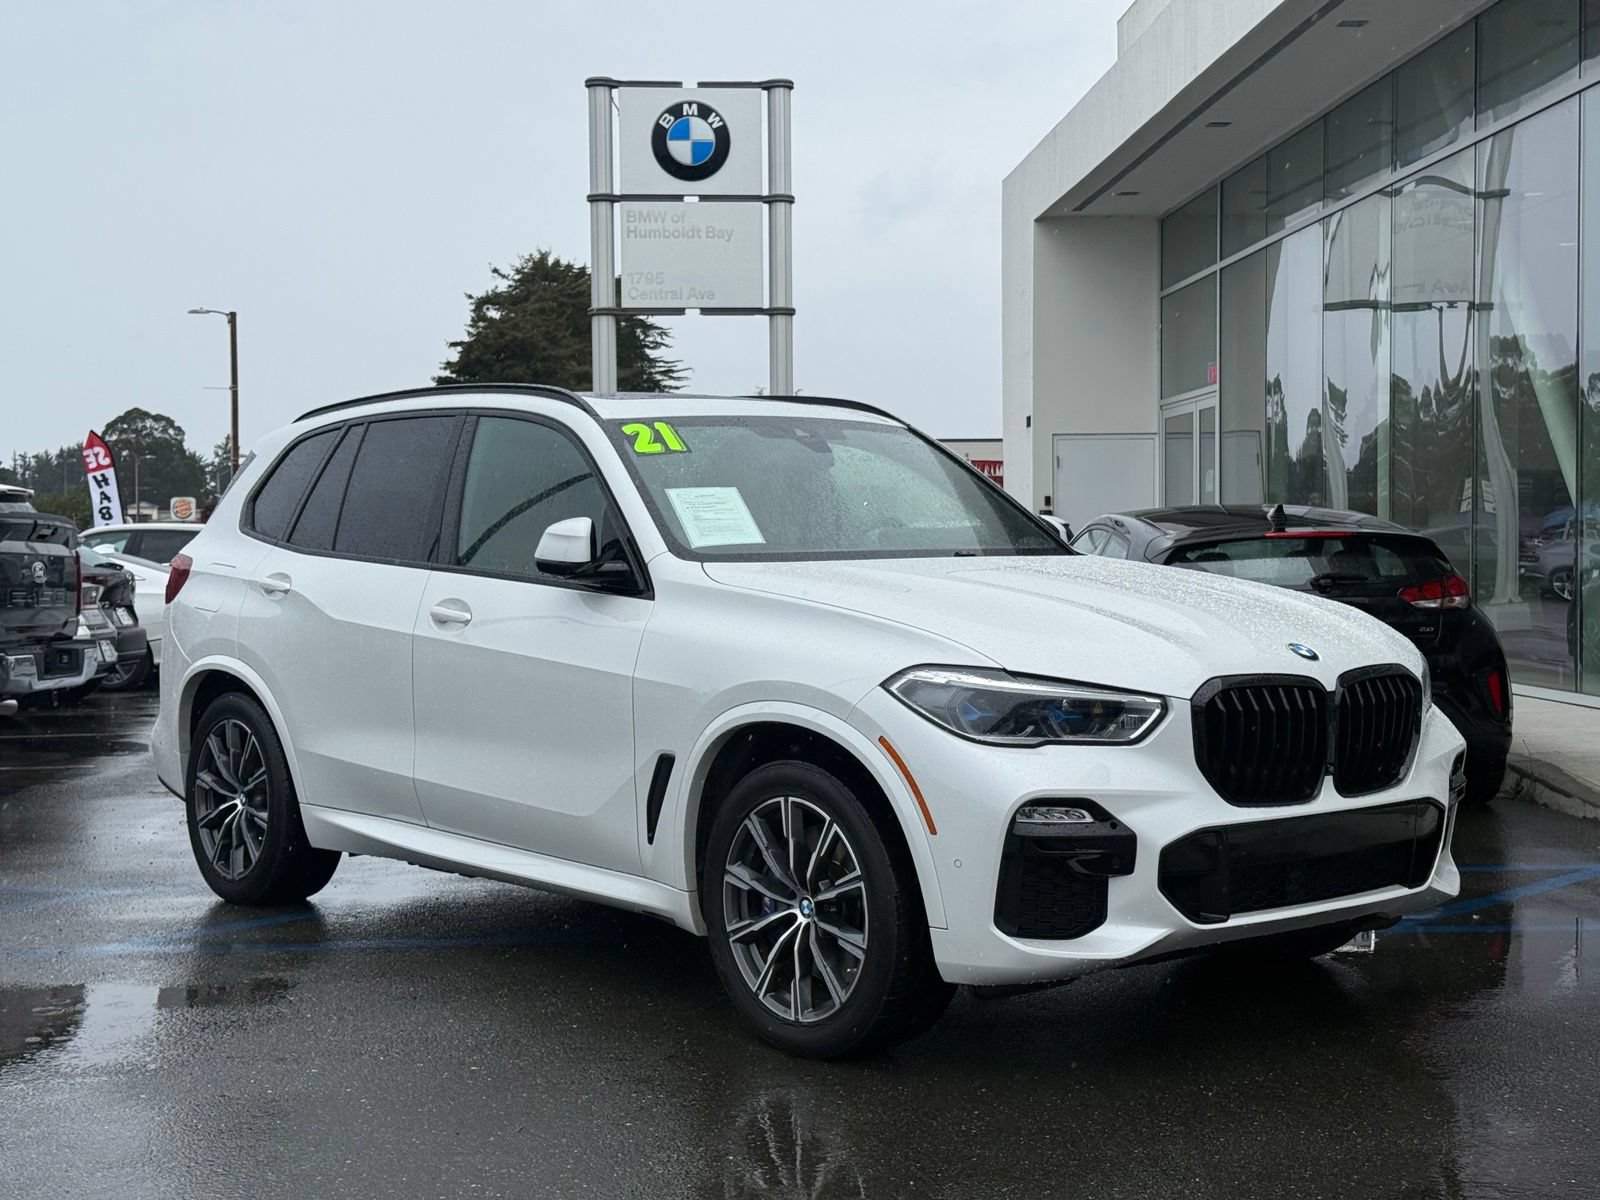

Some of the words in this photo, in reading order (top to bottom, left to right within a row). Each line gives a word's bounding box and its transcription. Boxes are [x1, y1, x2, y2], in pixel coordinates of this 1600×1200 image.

[658, 103, 724, 130] BMW
[626, 210, 667, 224] BMW
[670, 210, 687, 224] of
[626, 225, 702, 240] Humboldt
[705, 225, 735, 242] Bay
[627, 272, 665, 285] 1795
[627, 286, 683, 301] Central
[687, 286, 716, 301] Ave
[621, 421, 688, 454] 21
